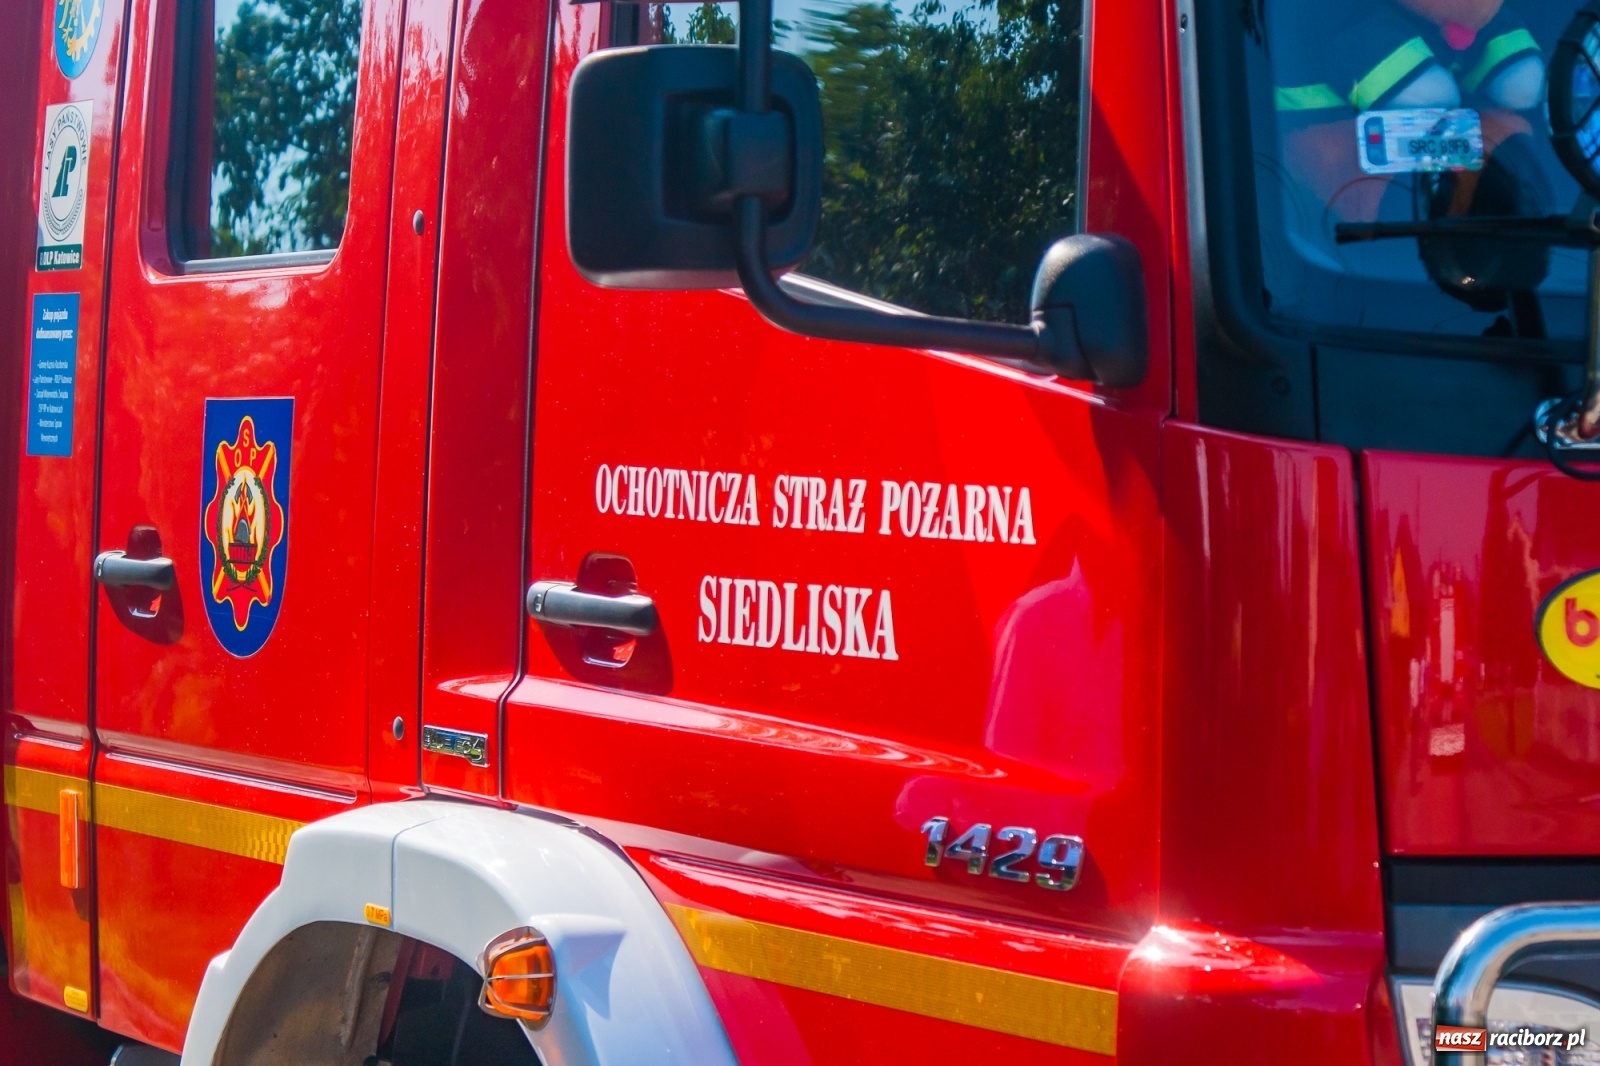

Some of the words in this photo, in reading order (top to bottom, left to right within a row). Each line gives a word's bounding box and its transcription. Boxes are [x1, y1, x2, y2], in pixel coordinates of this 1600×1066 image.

[45, 128, 56, 170] LASY
[1409, 139, 1437, 155] SRC
[53, 249, 80, 265] Katowice
[595, 462, 760, 527] OCHOTNICZA
[697, 574, 899, 661] SIEDLISKA
[920, 815, 1085, 892] 1429
